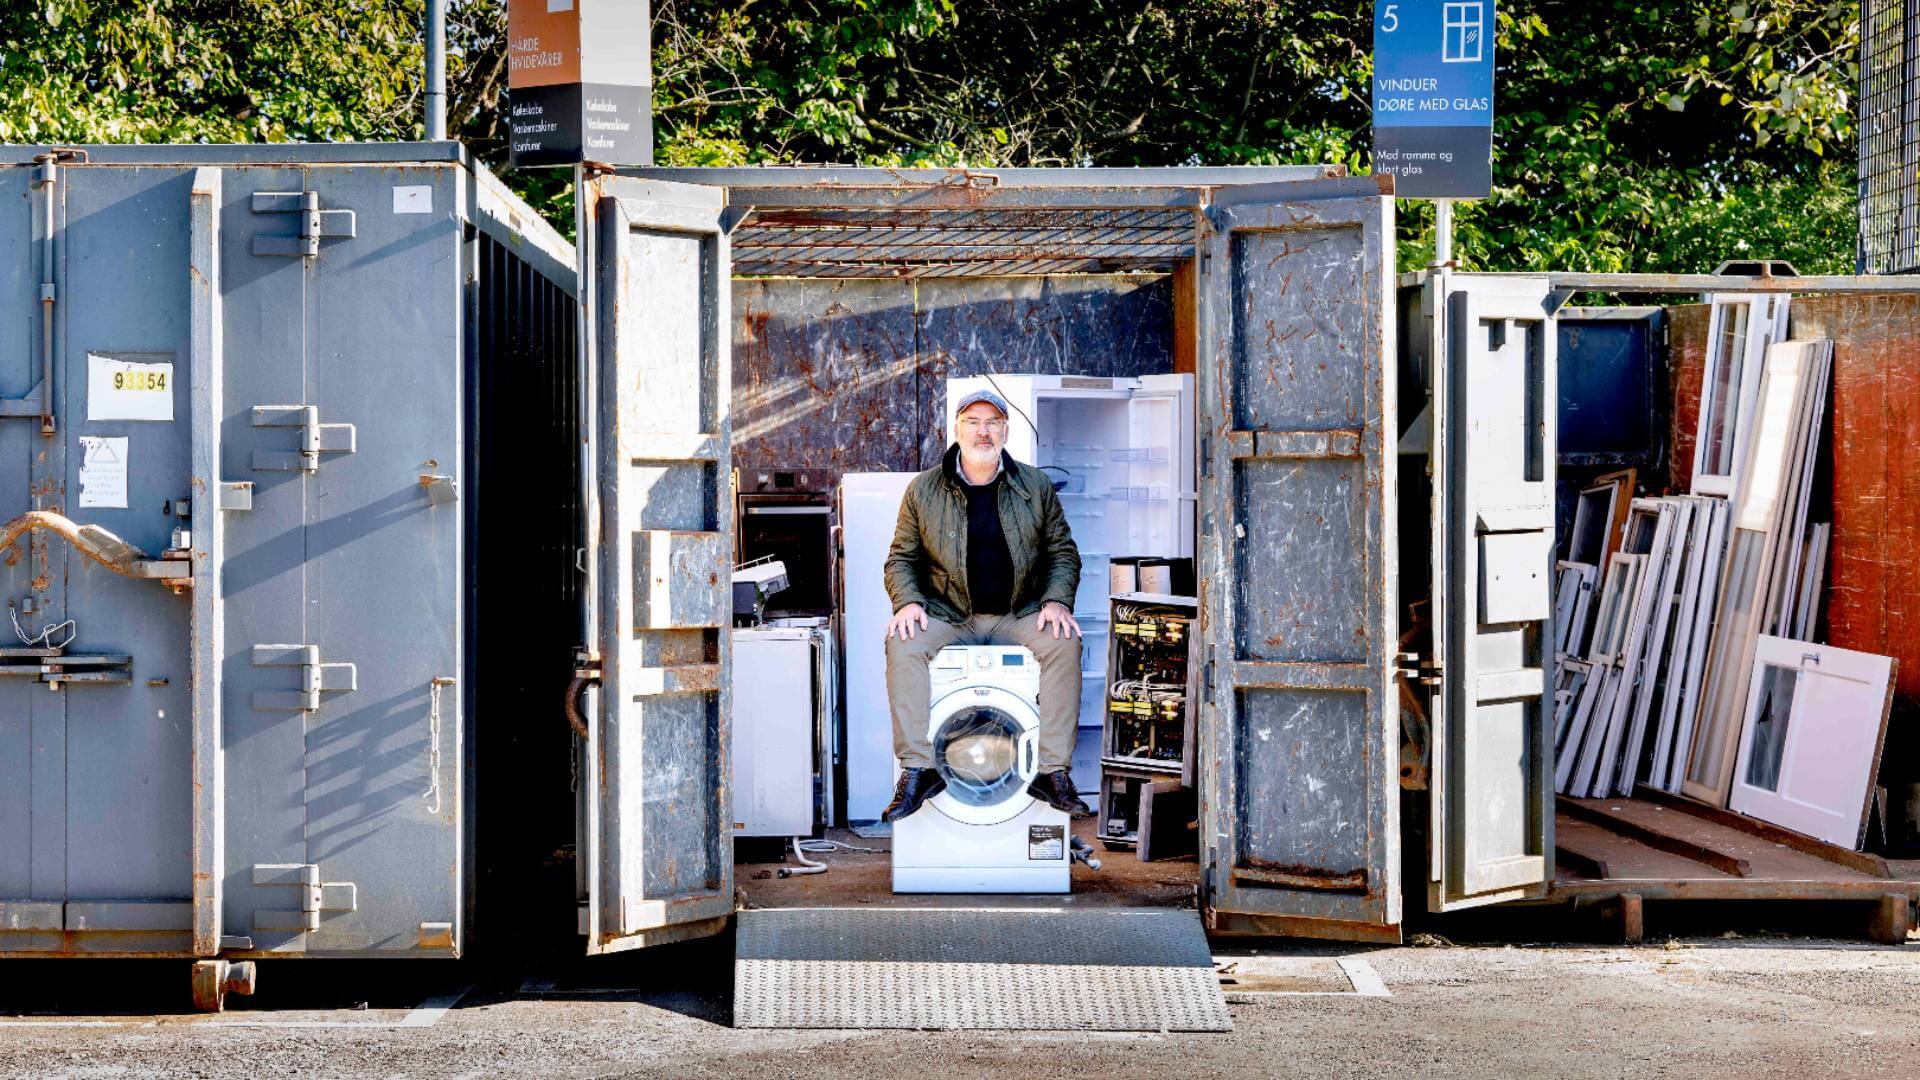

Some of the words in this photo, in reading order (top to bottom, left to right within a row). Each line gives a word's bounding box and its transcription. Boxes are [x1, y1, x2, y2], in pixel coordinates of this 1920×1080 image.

[1381, 5, 1399, 32] 5
[511, 36, 539, 53] HÅRDE
[1379, 78, 1438, 92] VINDUER
[1378, 97, 1415, 112] DØRE
[1419, 98, 1449, 111] MED
[1453, 97, 1489, 111] GLAS
[1376, 148, 1399, 161] Med
[1401, 151, 1437, 161] ramme
[1439, 151, 1453, 163] og
[1377, 162, 1399, 175] klart
[1401, 162, 1423, 176] glas
[114, 372, 166, 390] 93354
